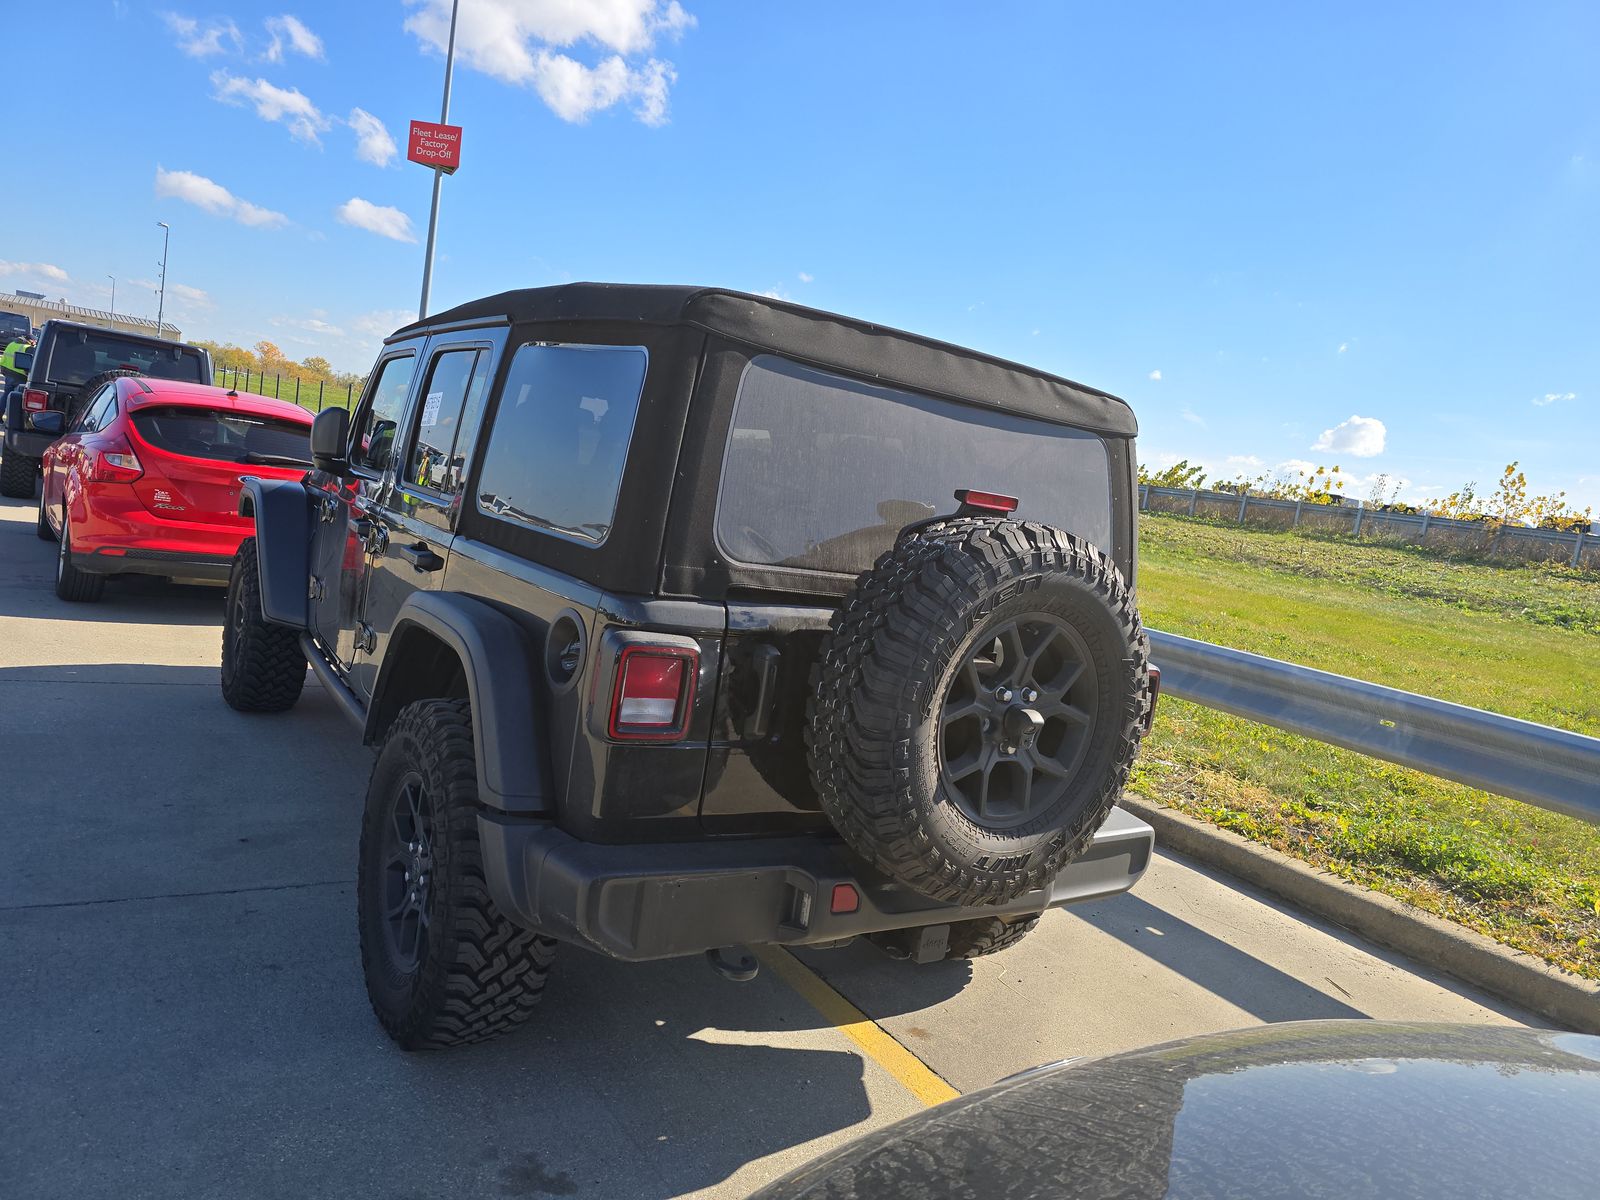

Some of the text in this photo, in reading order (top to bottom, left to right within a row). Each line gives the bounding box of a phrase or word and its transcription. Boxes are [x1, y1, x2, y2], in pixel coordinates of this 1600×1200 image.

[412, 127, 458, 142] Fleet Lease/
[420, 138, 449, 150] Factory
[416, 147, 452, 159] Drop-Off
[971, 850, 1033, 873] M/T
